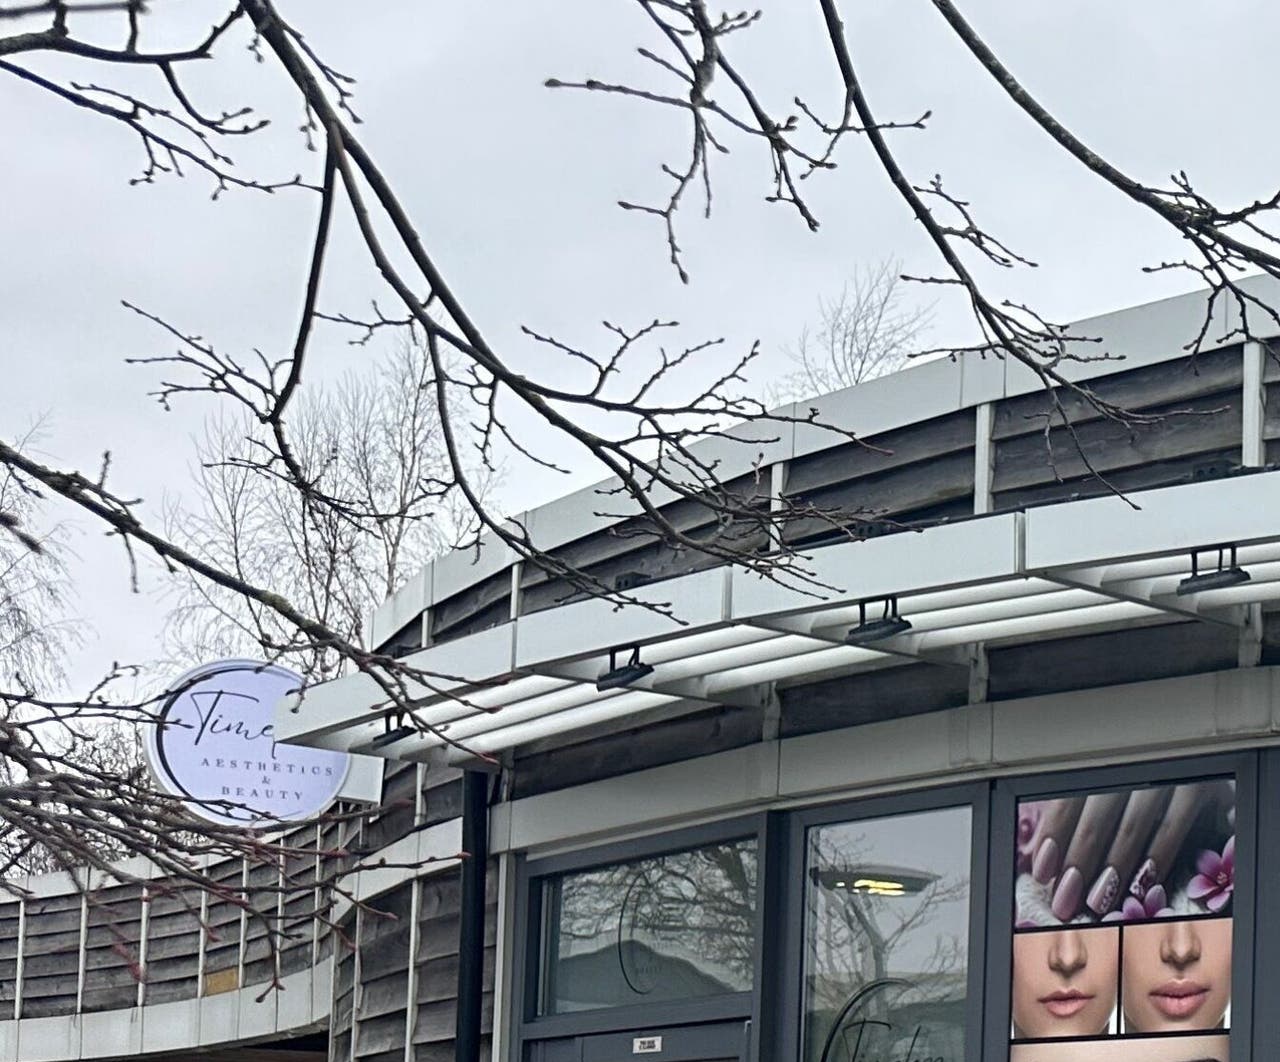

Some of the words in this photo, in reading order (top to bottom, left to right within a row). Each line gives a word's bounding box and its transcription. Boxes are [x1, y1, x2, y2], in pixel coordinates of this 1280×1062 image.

[190, 690, 276, 760] Time
[201, 758, 333, 776] AESTHETICS
[262, 776, 271, 784] &
[222, 786, 303, 800] BEAUTY
